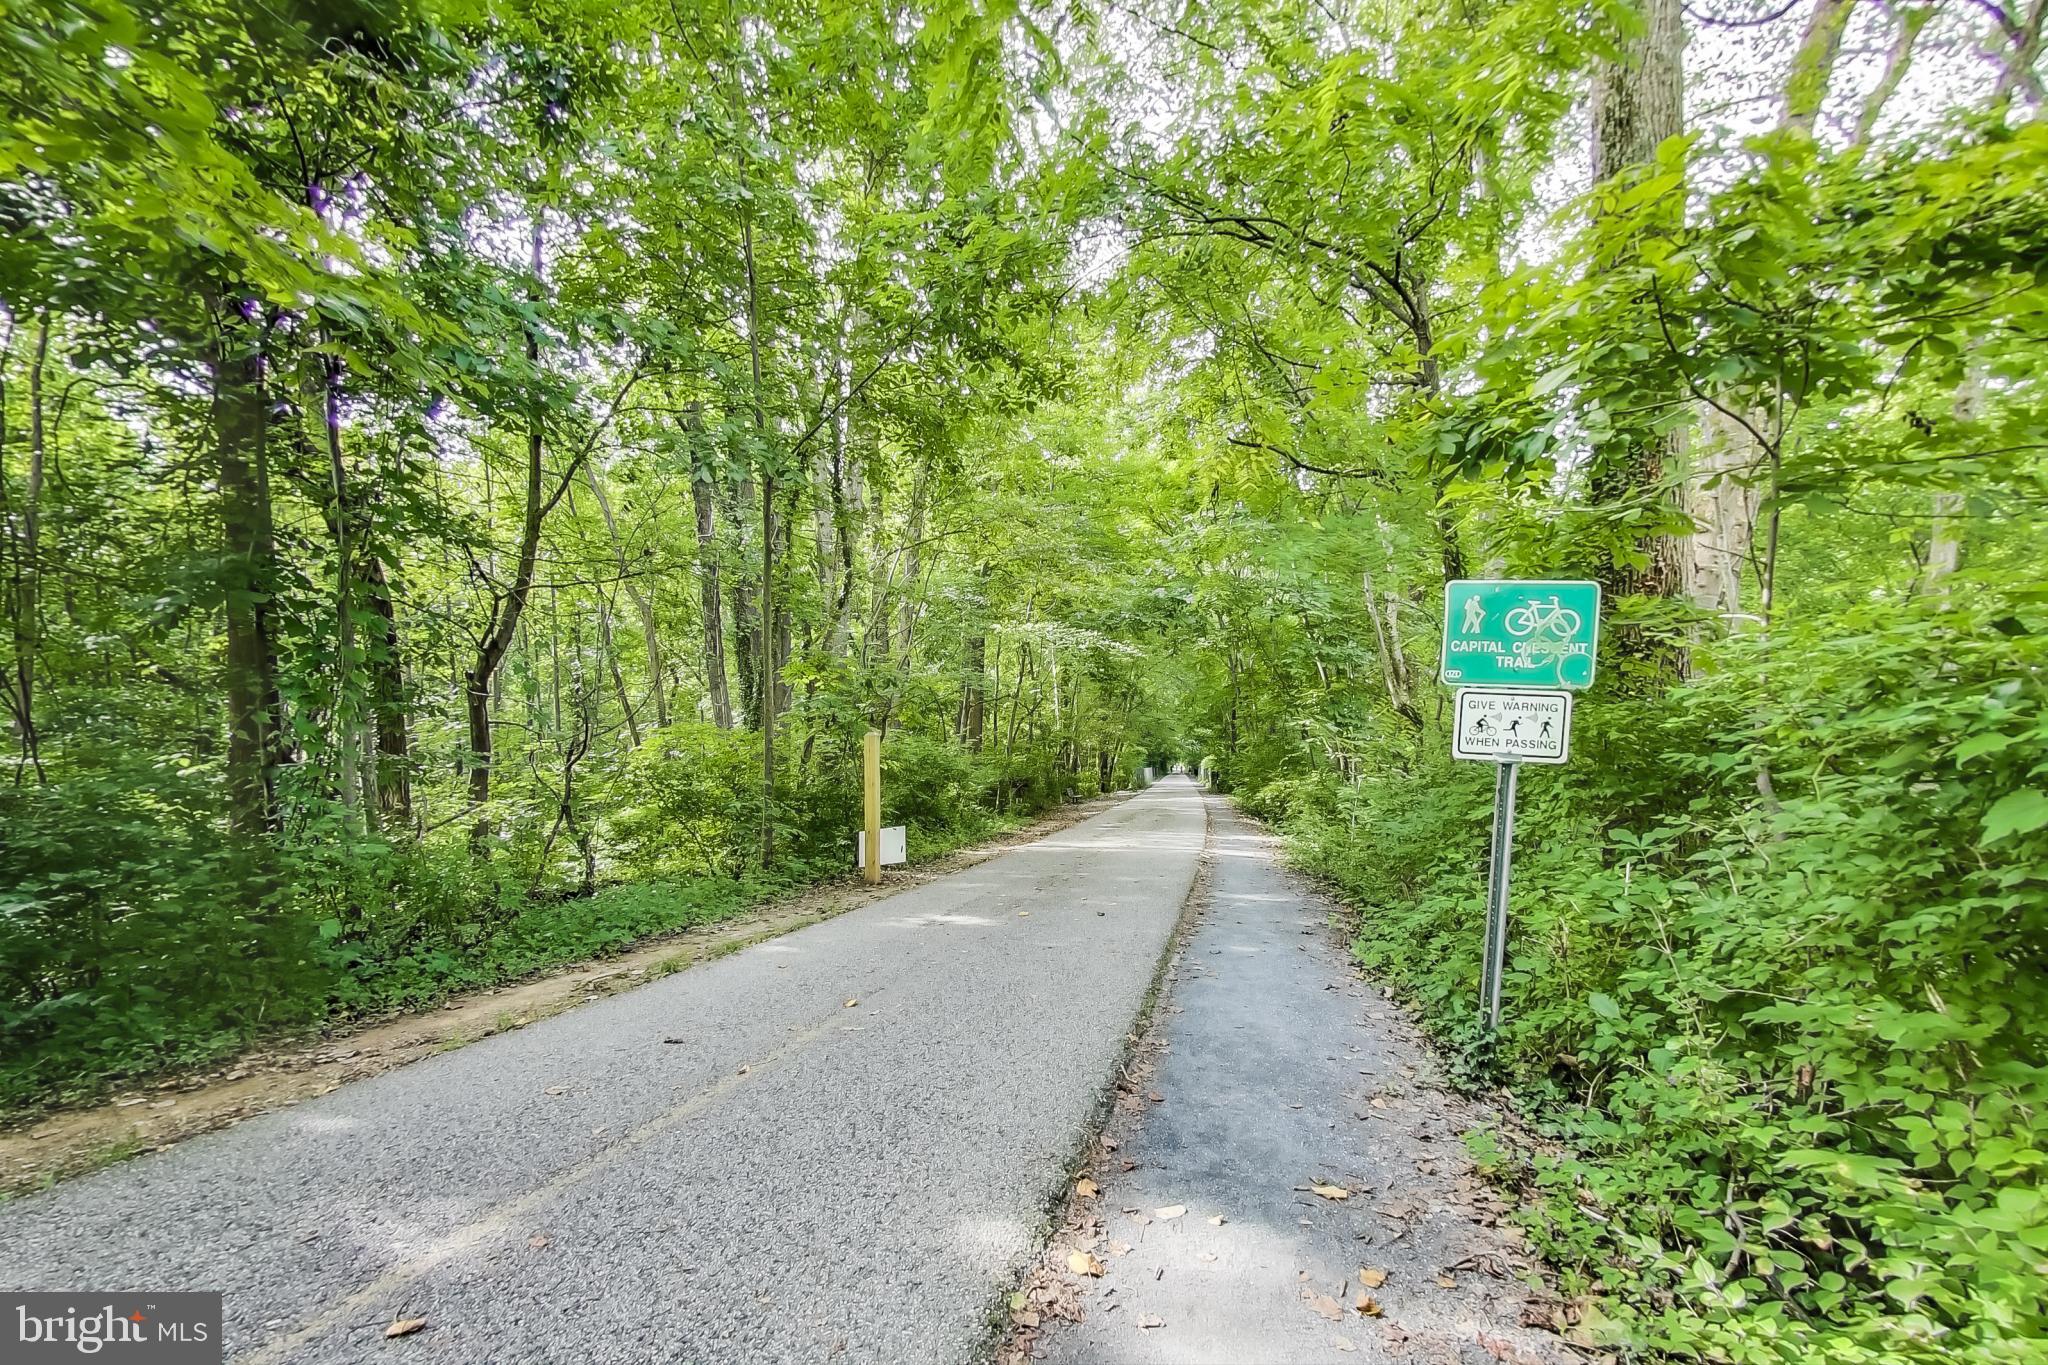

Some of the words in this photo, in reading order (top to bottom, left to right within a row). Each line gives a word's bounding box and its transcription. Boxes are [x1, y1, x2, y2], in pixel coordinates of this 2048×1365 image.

[1450, 640, 1506, 653] CAPITAL
[1512, 641, 1589, 654] CESENT
[1495, 655, 1536, 669] TRAIL
[1468, 700, 1496, 710] GIVE
[1502, 701, 1559, 713] WARNING
[1465, 736, 1500, 747] WHEN
[1505, 738, 1557, 750] PASSING
